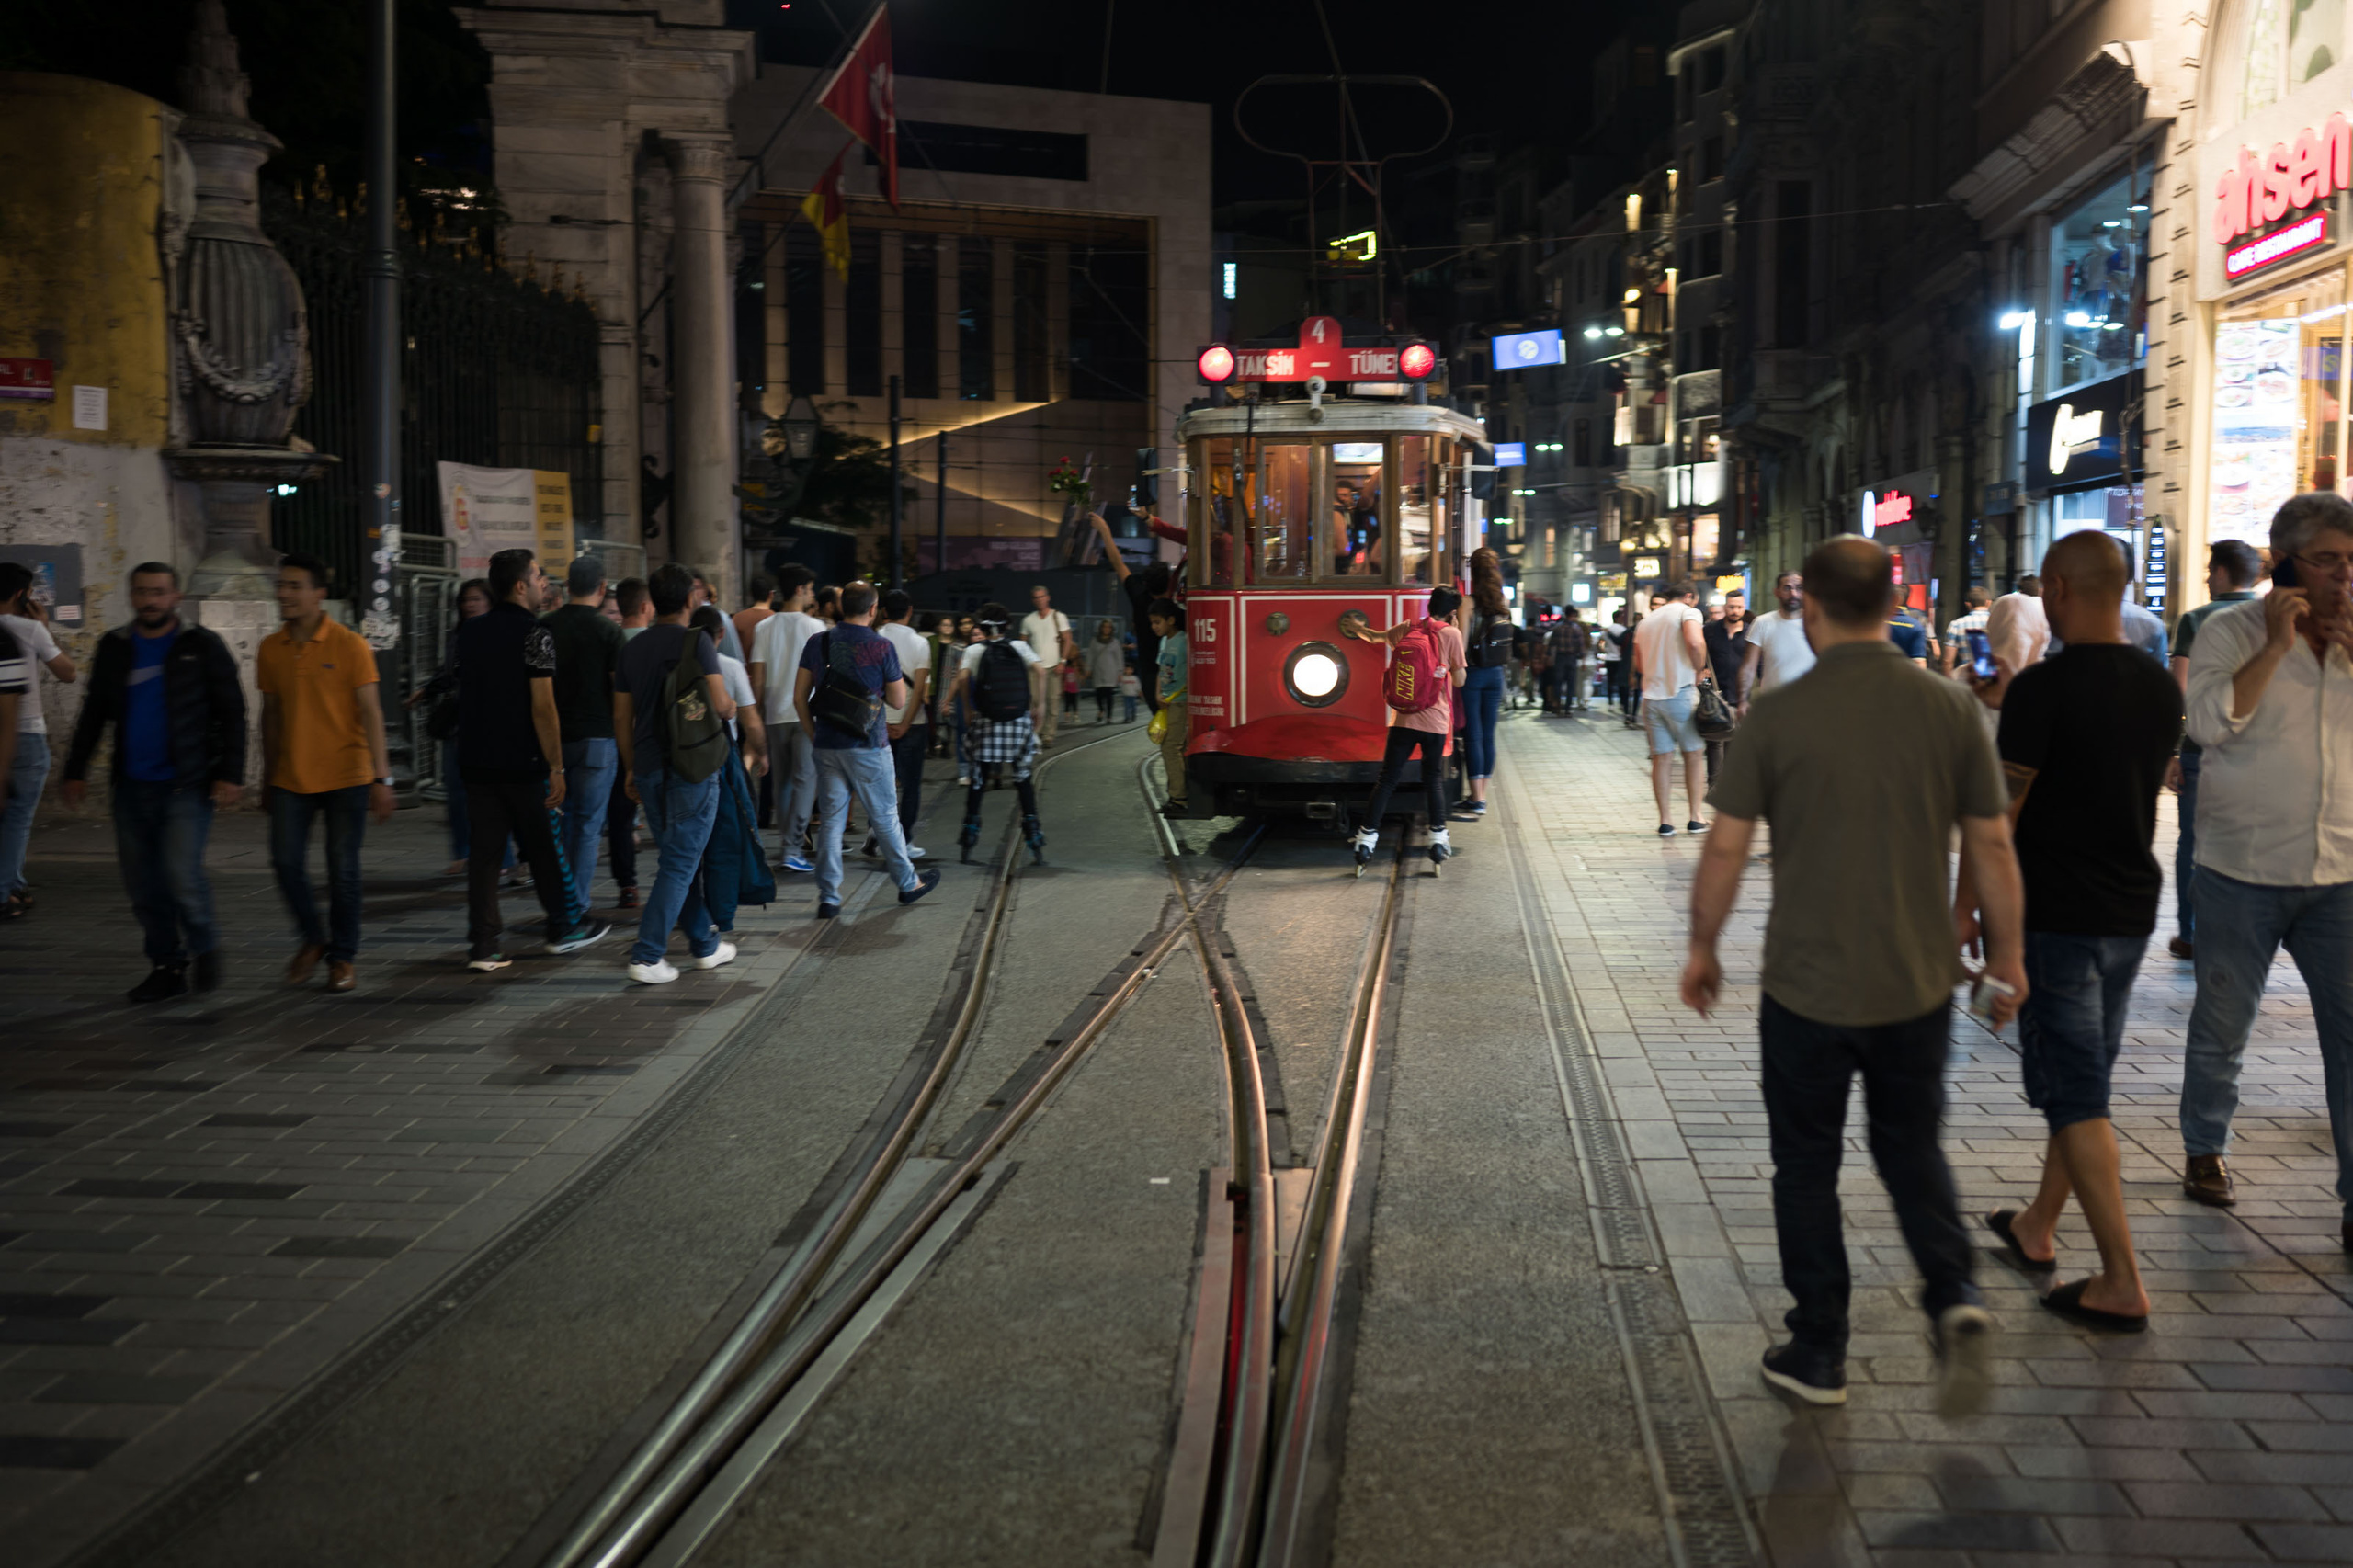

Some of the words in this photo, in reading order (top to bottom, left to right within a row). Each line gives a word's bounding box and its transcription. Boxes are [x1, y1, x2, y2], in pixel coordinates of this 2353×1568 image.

[2213, 111, 2351, 244] ahsen
[1311, 318, 1324, 344] 4
[1194, 618, 1217, 642] 115
[1396, 661, 1415, 701] NIKE
